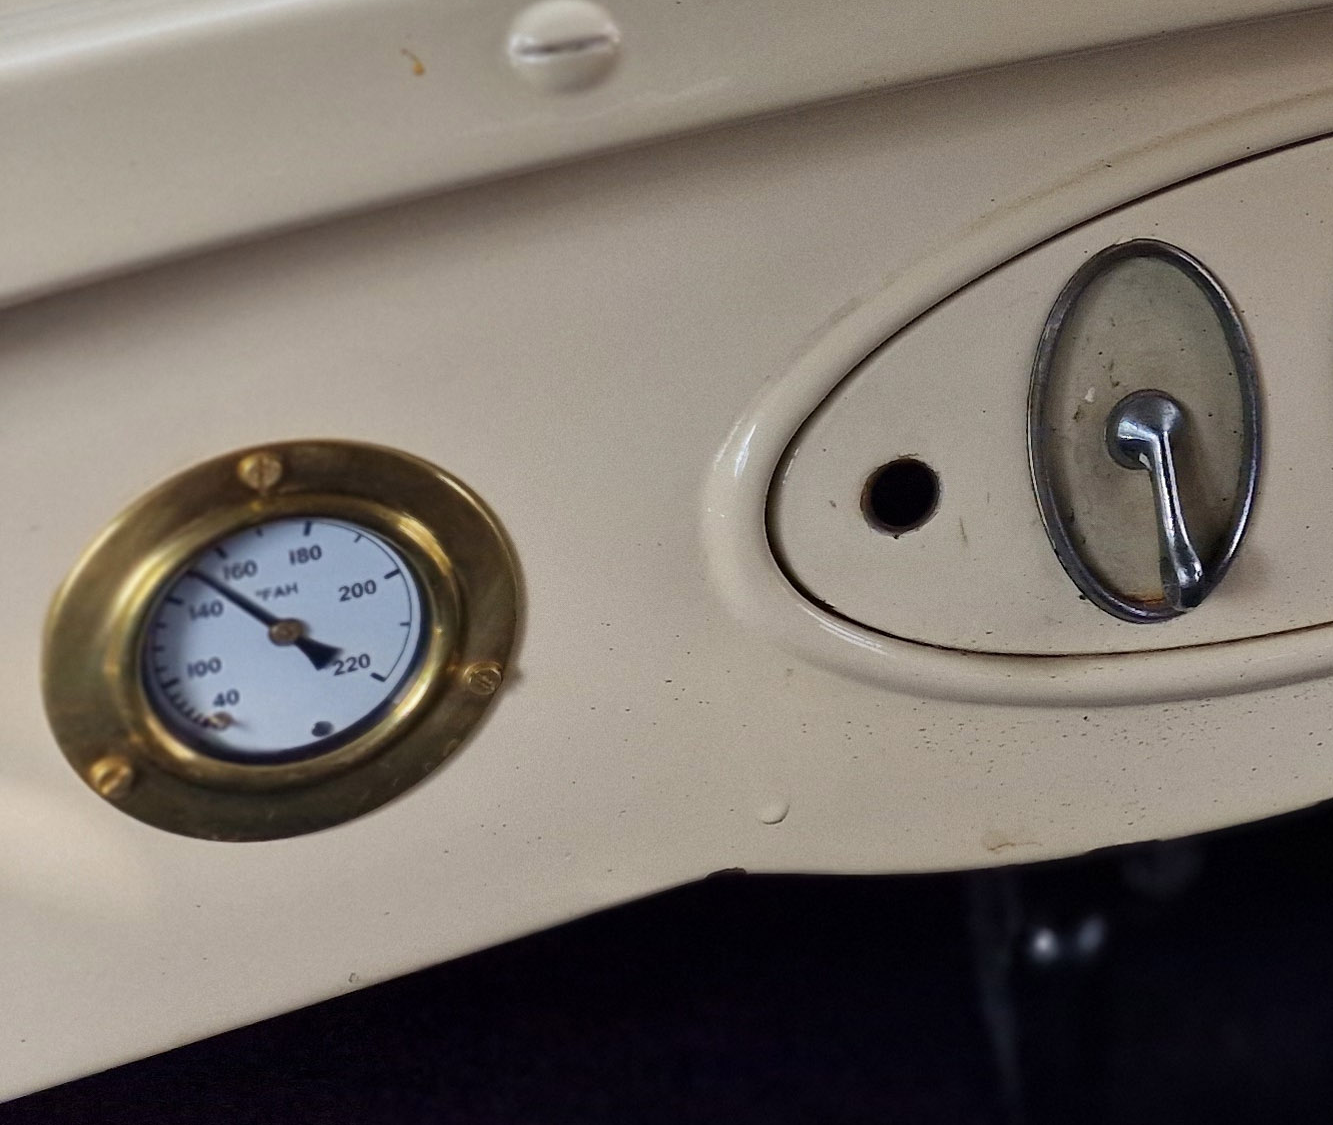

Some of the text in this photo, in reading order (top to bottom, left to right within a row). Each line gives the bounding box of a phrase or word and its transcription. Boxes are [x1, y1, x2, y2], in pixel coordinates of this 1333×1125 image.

[289, 544, 322, 566] 180
[223, 559, 258, 581] 160
[338, 579, 377, 602] 200
[188, 600, 223, 621] 140
[187, 657, 222, 678] 100
[333, 653, 371, 676] 220
[212, 689, 240, 707] 40
